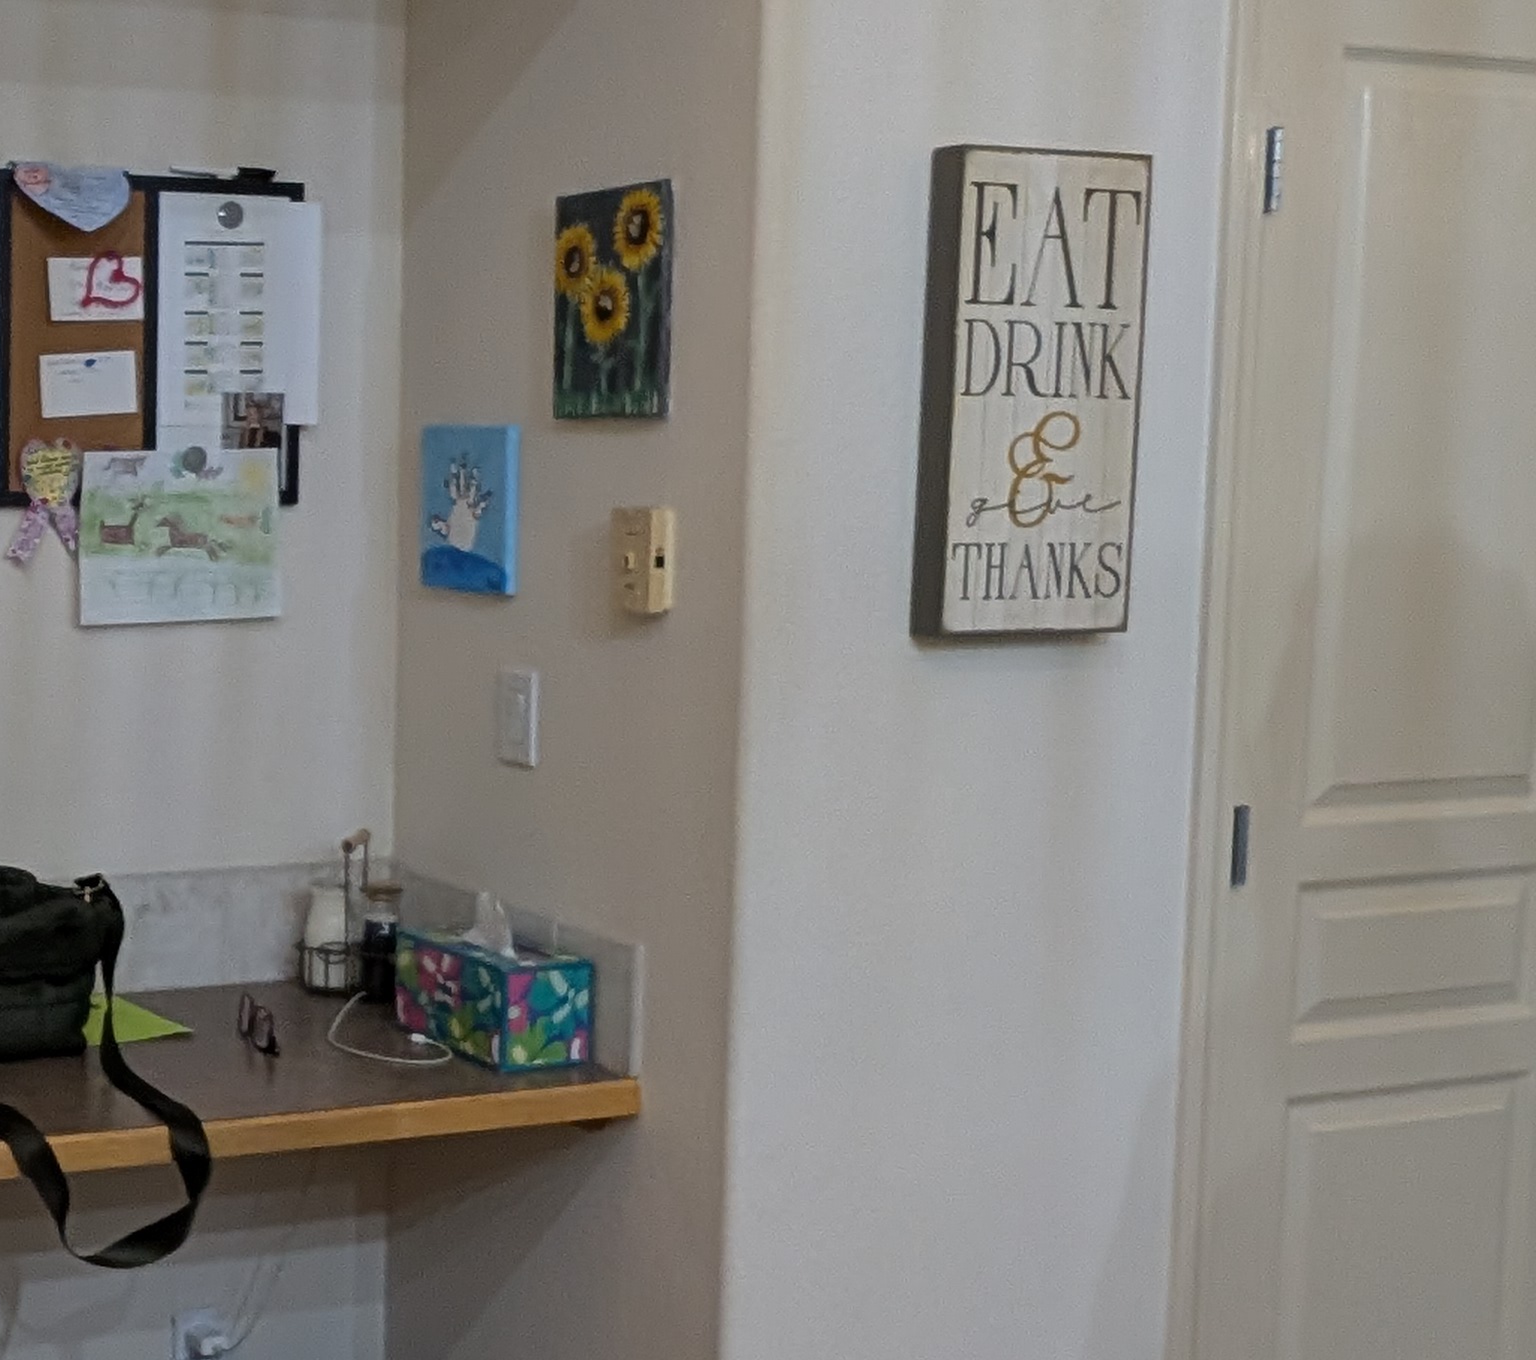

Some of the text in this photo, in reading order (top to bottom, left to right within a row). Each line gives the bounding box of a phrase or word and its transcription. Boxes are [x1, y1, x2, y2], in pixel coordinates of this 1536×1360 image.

[964, 180, 1142, 310] EAT
[960, 318, 1132, 401] DRINK
[951, 542, 1124, 602] THANKS
